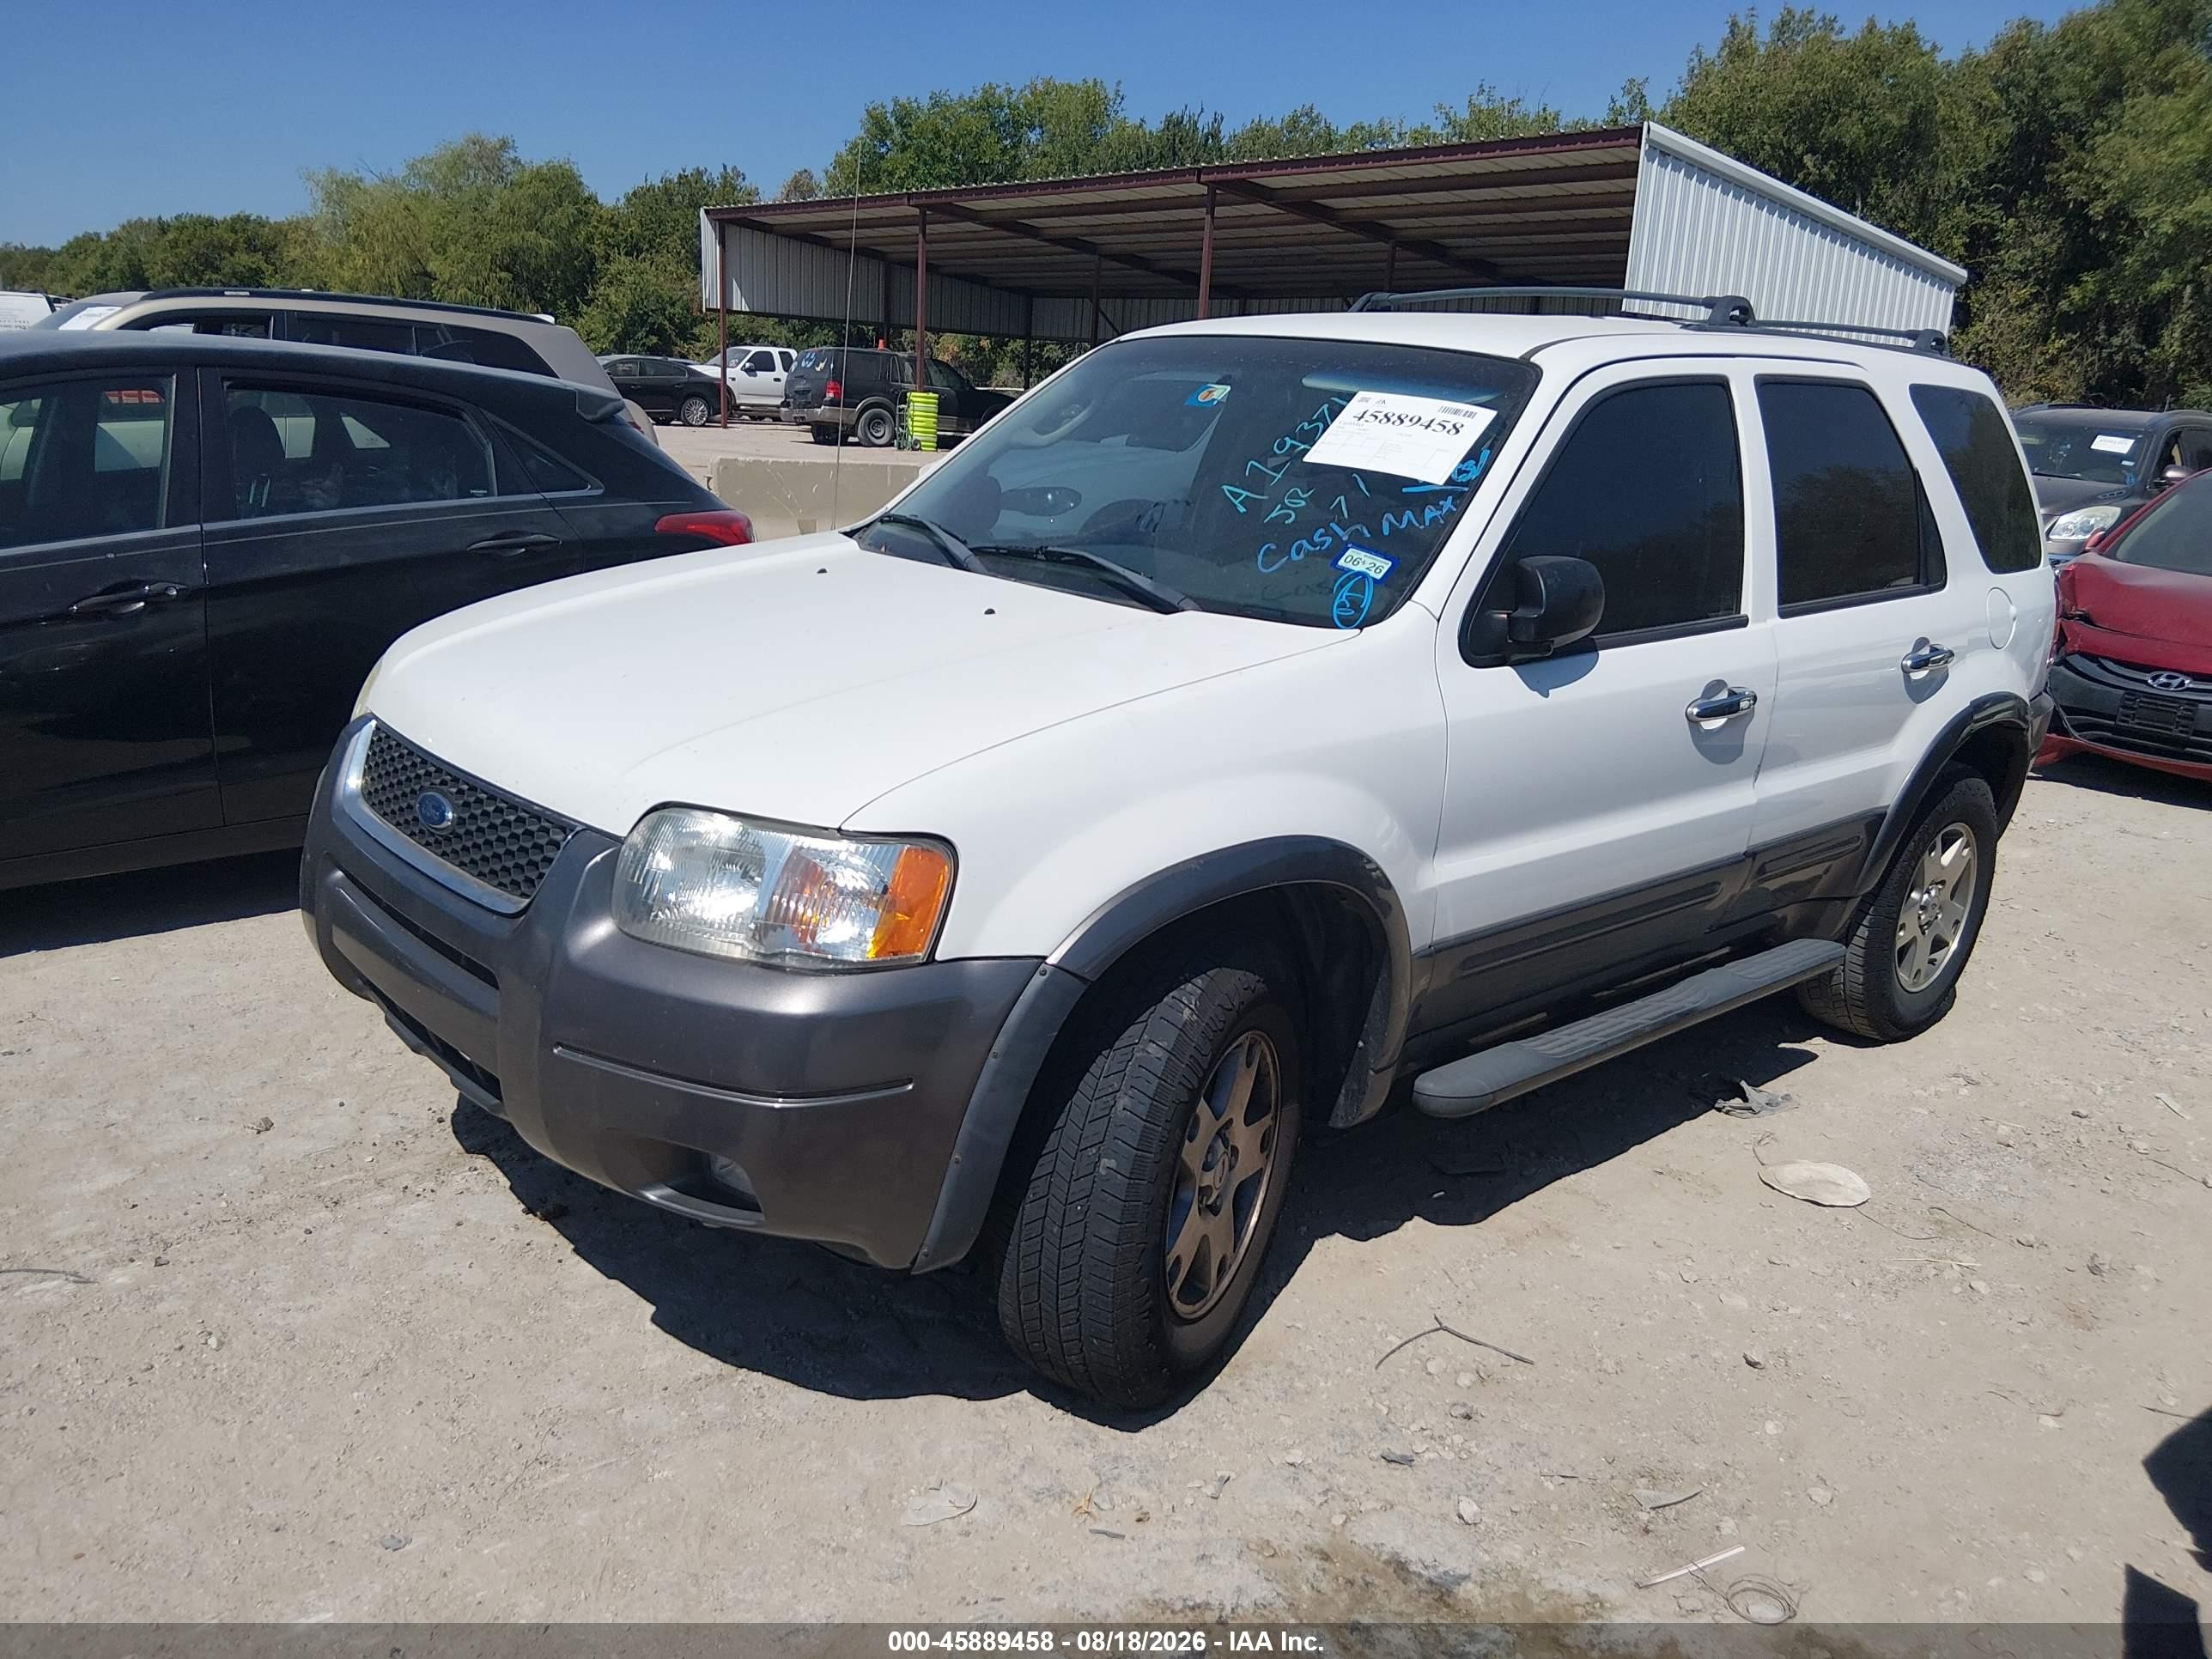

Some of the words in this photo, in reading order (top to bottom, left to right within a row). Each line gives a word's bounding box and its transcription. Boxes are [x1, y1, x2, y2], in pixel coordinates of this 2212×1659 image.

[1352, 409, 1464, 436] 45889458
[1256, 522, 1371, 573] Cash
[1343, 555, 1363, 567] 06
[1364, 562, 1385, 574] 26
